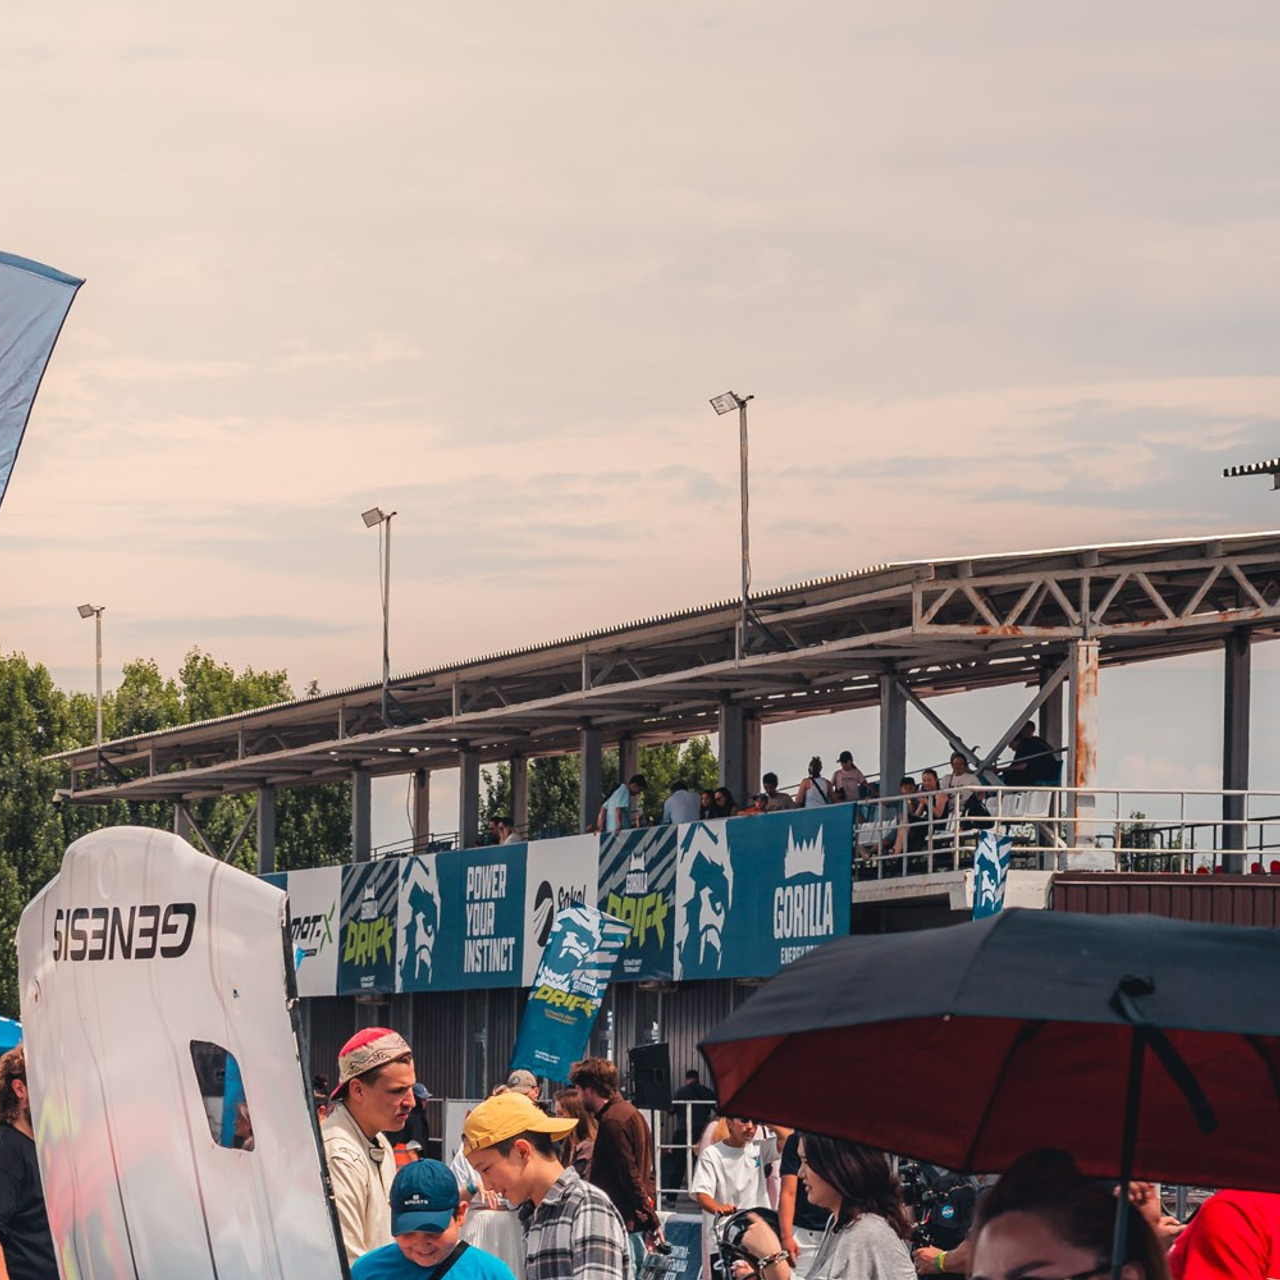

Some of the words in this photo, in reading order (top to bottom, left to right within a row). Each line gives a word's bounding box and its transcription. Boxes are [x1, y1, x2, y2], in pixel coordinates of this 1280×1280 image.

[466, 863, 507, 901] POWER
[466, 901, 496, 937] YOUR
[774, 881, 834, 940] GORILLA
[53, 902, 196, 962] GENESIS
[463, 936, 516, 974] INSTINCT
